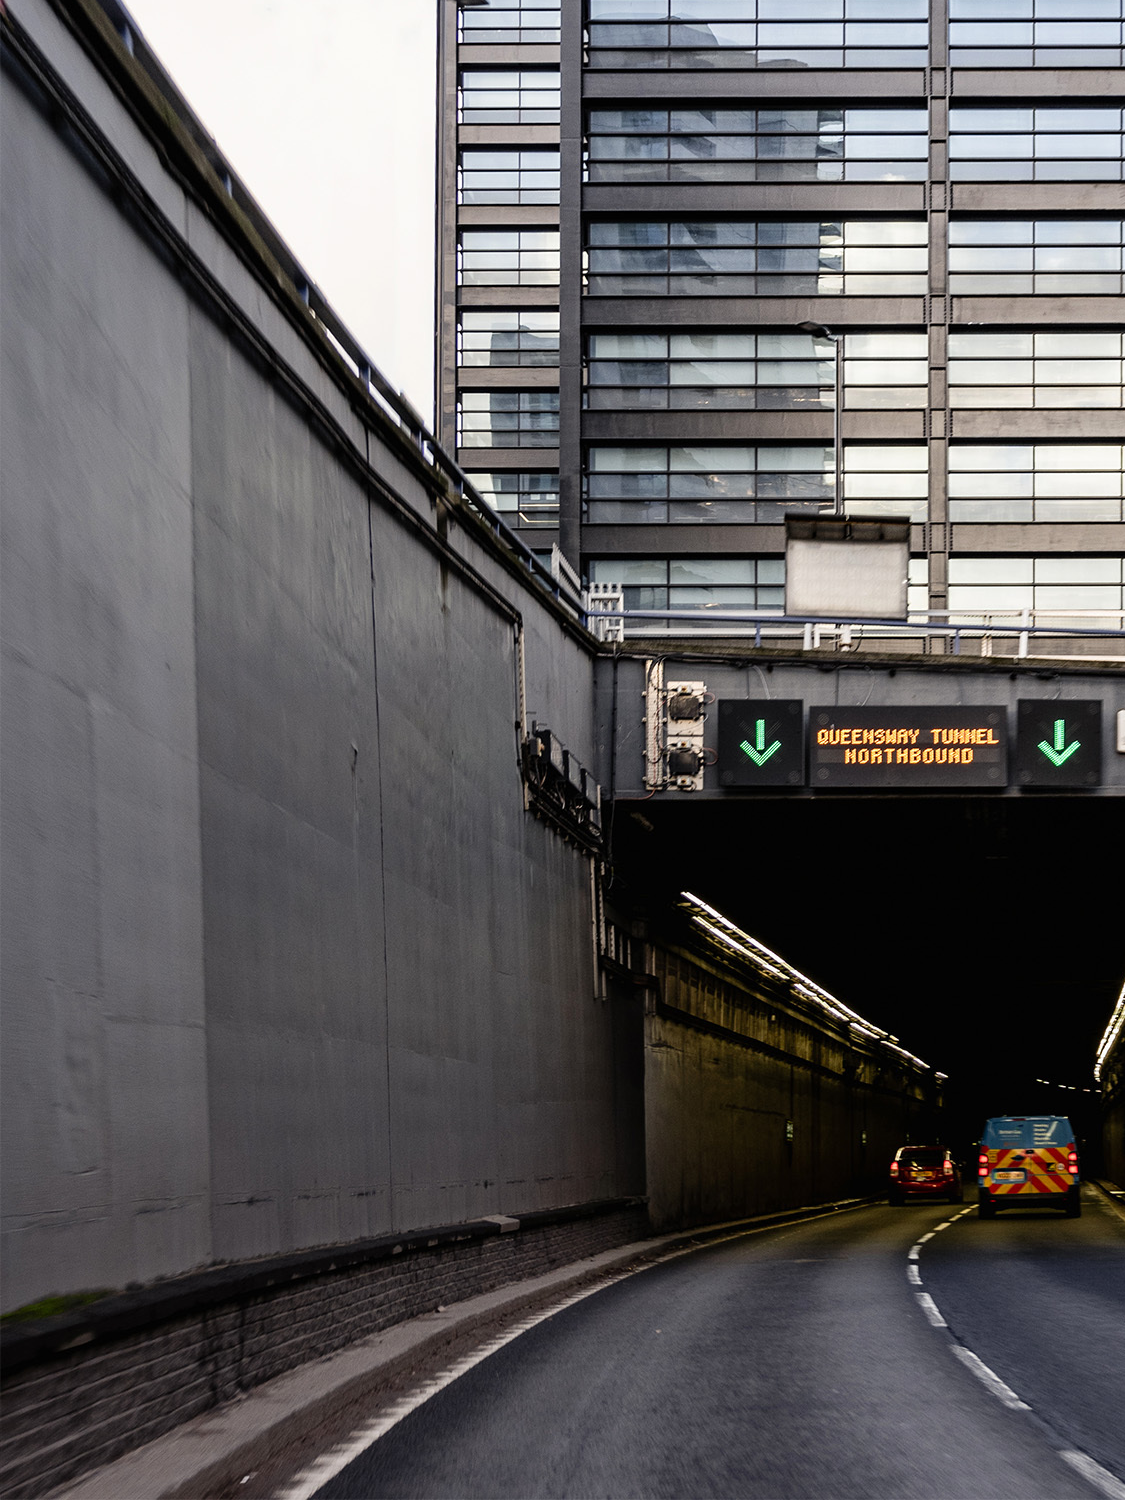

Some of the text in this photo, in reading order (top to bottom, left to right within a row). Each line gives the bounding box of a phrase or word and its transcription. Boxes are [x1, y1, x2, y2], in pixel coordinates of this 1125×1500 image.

[817, 728, 1000, 745] QUEENSWAY TUNNEL
[844, 747, 974, 764] NORTHBOUND
